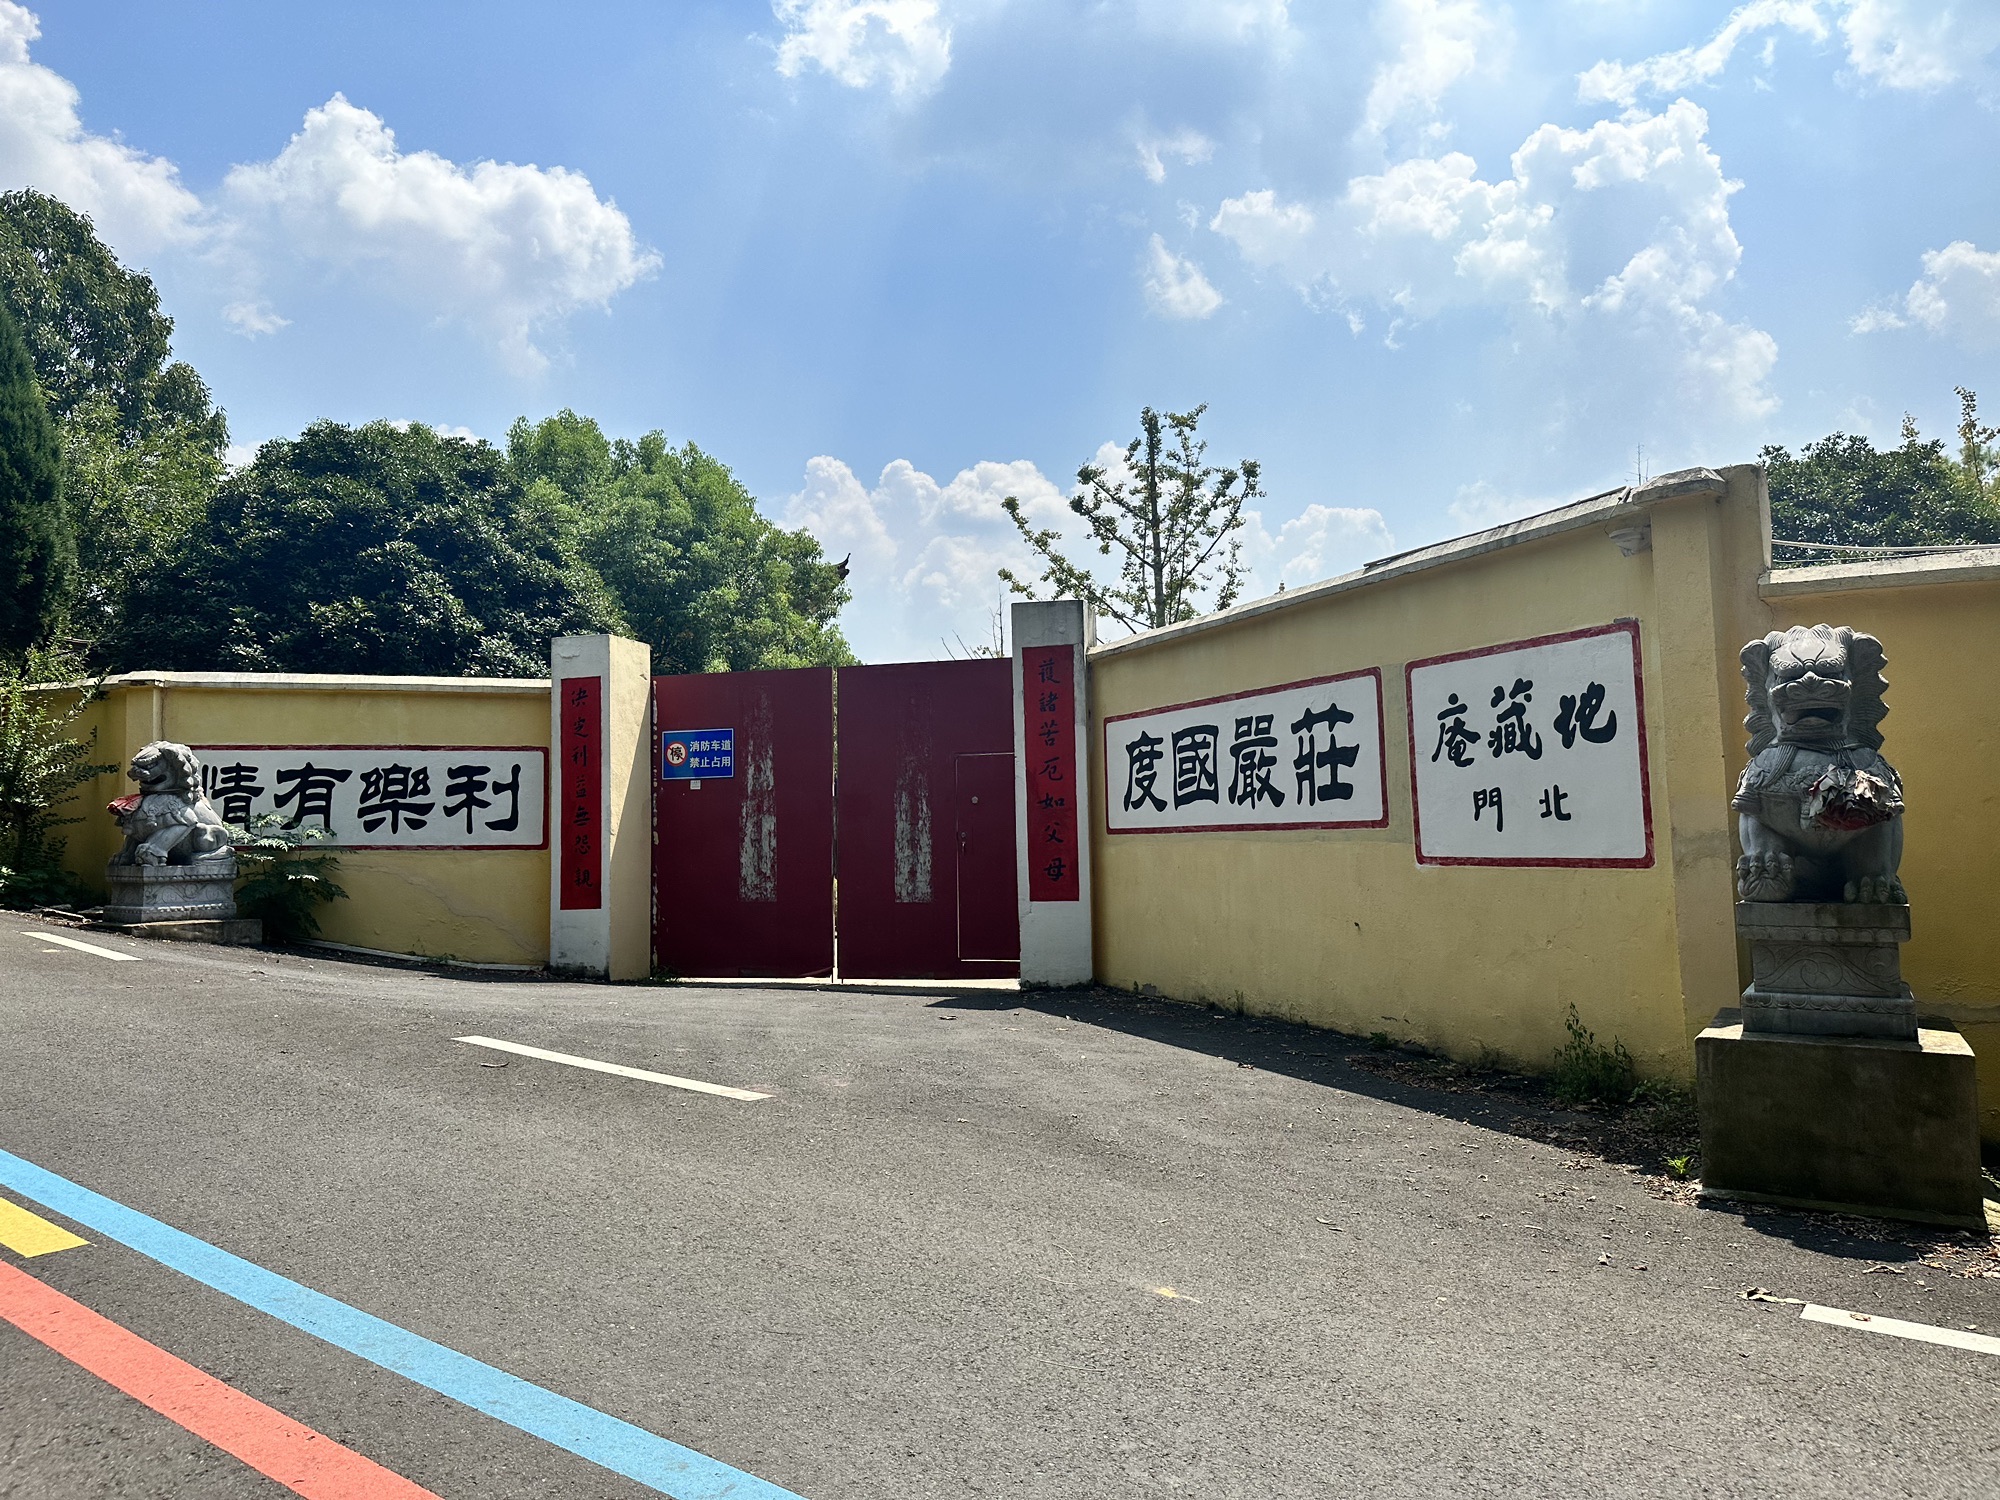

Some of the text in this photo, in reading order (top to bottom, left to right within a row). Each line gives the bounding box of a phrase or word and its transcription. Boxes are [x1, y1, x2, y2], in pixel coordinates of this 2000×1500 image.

[1431, 677, 1618, 768] 地藏庵
[689, 740, 731, 752] 消防车道
[689, 756, 731, 768] 禁止占用
